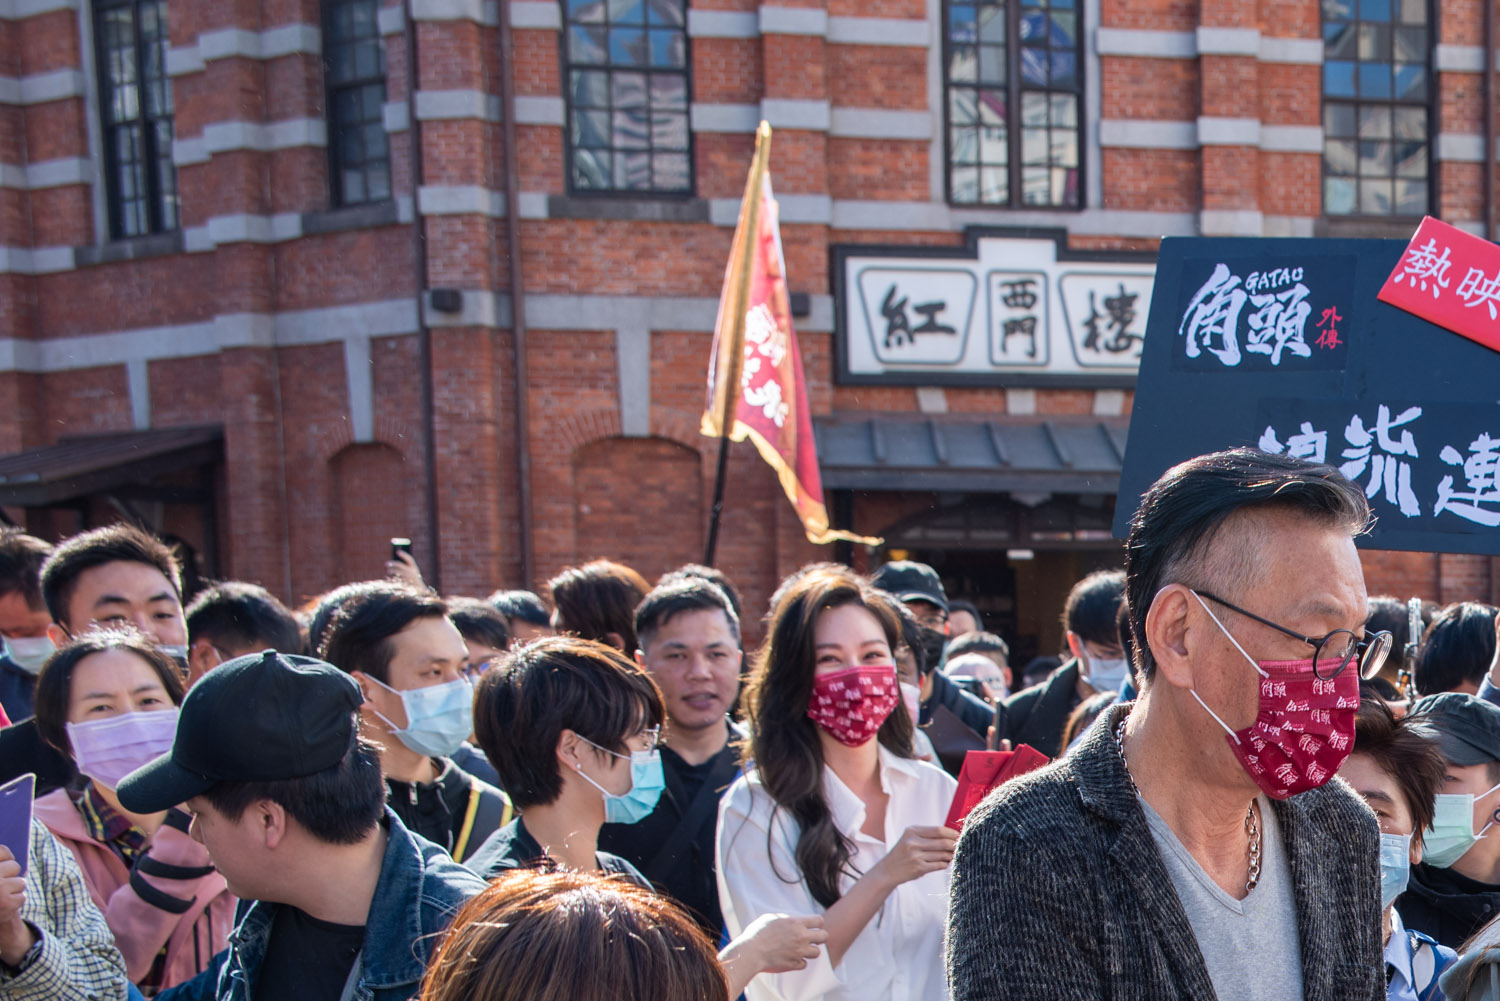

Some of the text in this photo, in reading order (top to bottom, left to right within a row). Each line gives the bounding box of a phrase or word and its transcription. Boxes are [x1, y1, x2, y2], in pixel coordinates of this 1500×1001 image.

[881, 283, 957, 348] 紅
[999, 279, 1038, 359] 西門
[1178, 263, 1312, 366] 角頭
[1315, 306, 1343, 350] 外傳
